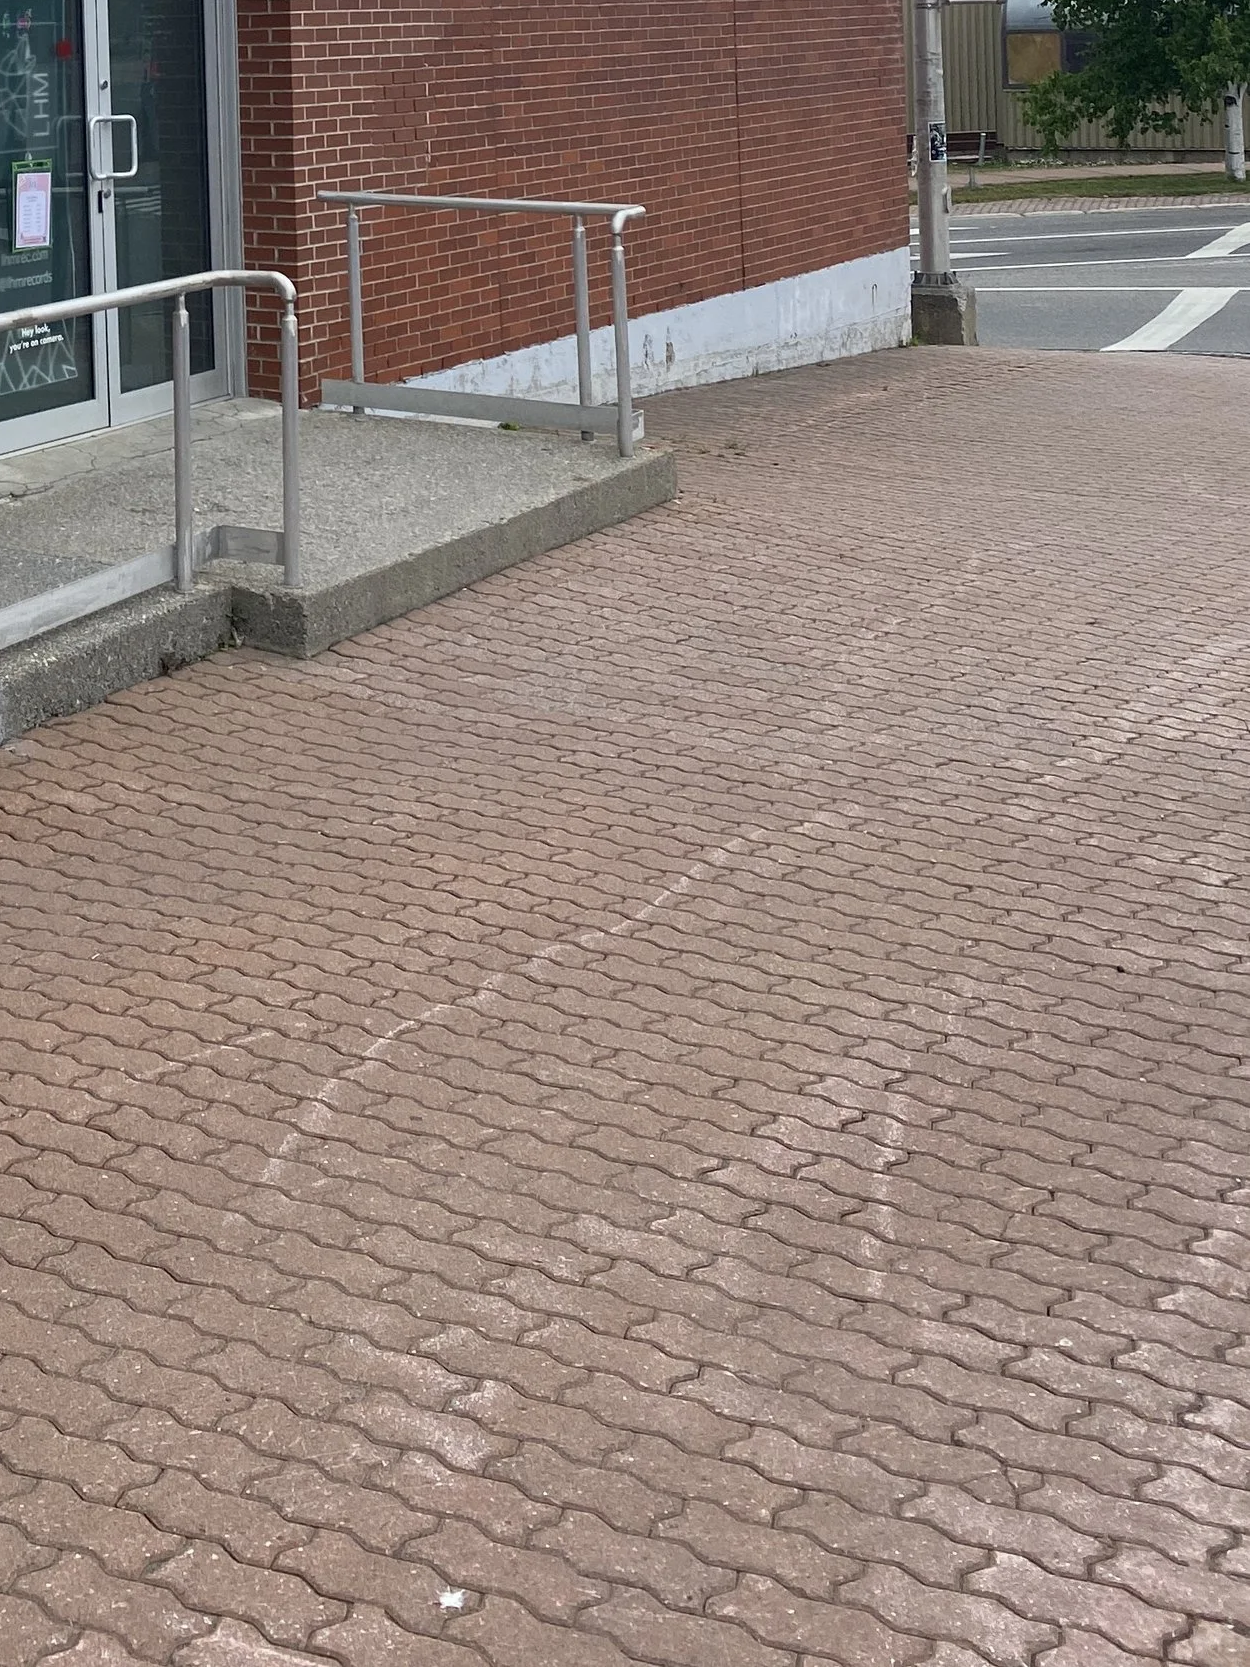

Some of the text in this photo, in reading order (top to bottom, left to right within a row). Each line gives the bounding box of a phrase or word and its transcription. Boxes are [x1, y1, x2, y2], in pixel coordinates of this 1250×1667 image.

[21, 322, 51, 338] Hey look,
[9, 334, 65, 354] you're on camera.
